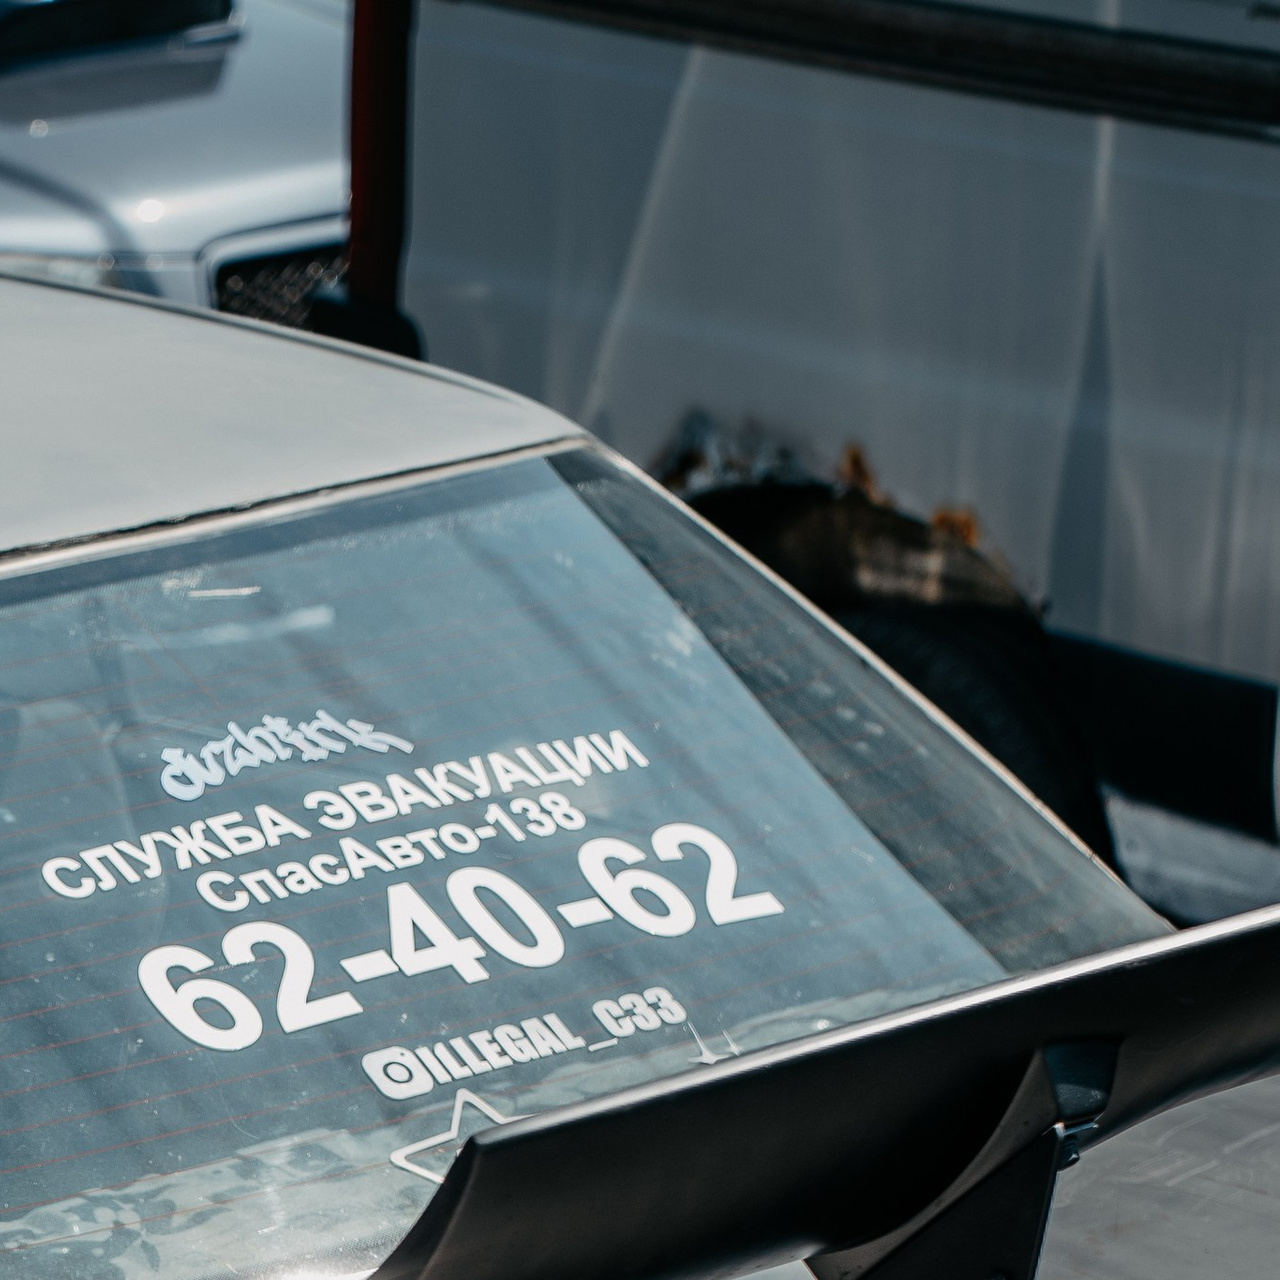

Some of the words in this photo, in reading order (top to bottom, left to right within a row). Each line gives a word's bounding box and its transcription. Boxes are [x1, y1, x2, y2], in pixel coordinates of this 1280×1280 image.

[41, 804, 312, 899] СЛУЖБА
[303, 729, 650, 831] ЭВАКУАЦИИ
[196, 791, 588, 912] СпасАвто-138
[137, 822, 786, 1052] 62-40-62
